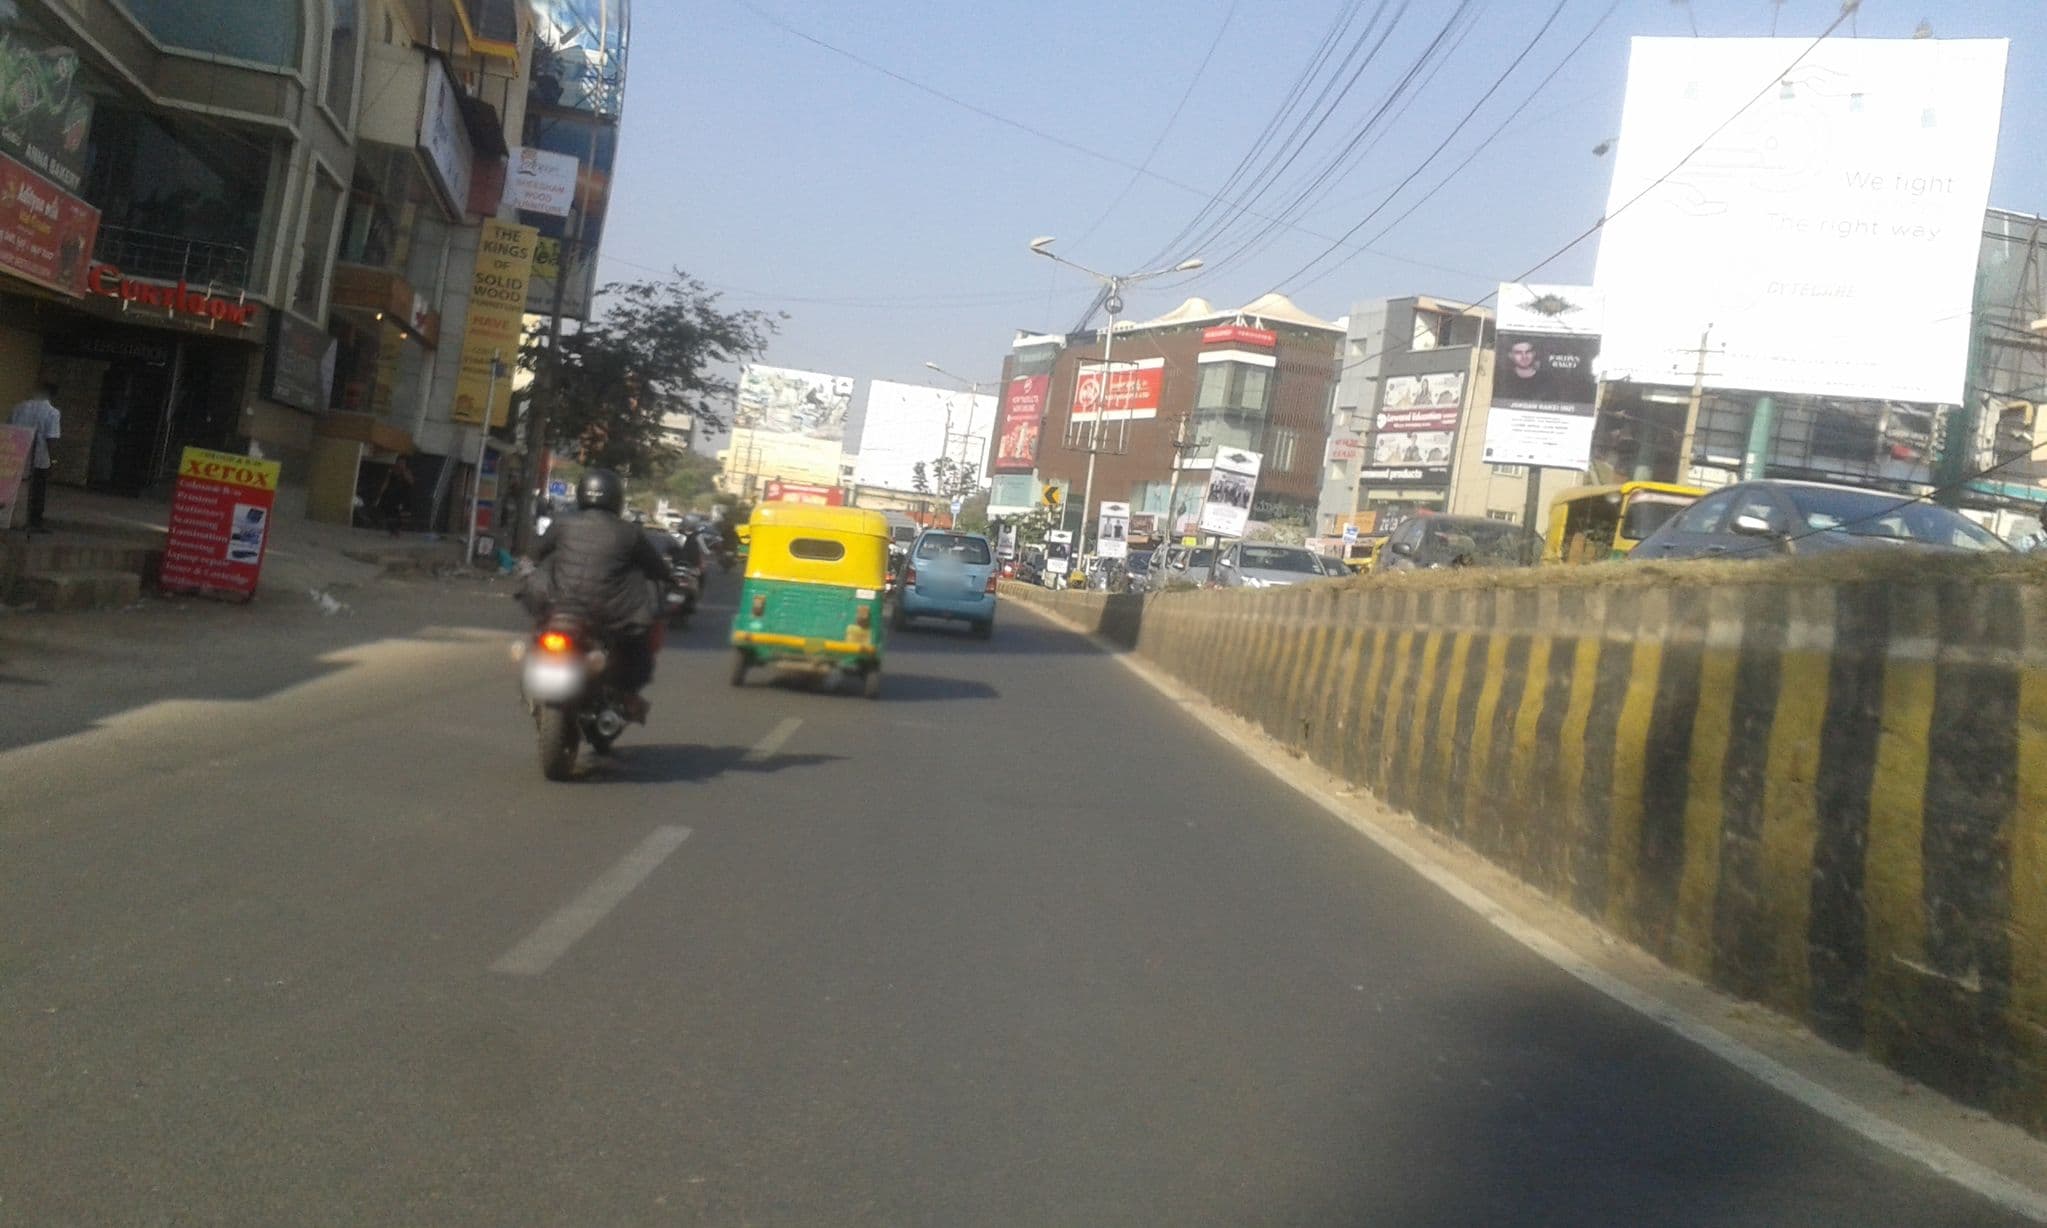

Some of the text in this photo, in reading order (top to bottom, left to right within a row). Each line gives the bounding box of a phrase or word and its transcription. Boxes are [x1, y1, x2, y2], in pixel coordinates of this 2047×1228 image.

[1846, 171, 1884, 191] We
[495, 226, 521, 243] THE
[1819, 217, 1879, 239] right
[1891, 223, 1942, 242] way
[484, 240, 528, 260] KINGS
[494, 260, 512, 271] OF
[475, 272, 523, 290] SOLID
[473, 285, 521, 302] WOOD
